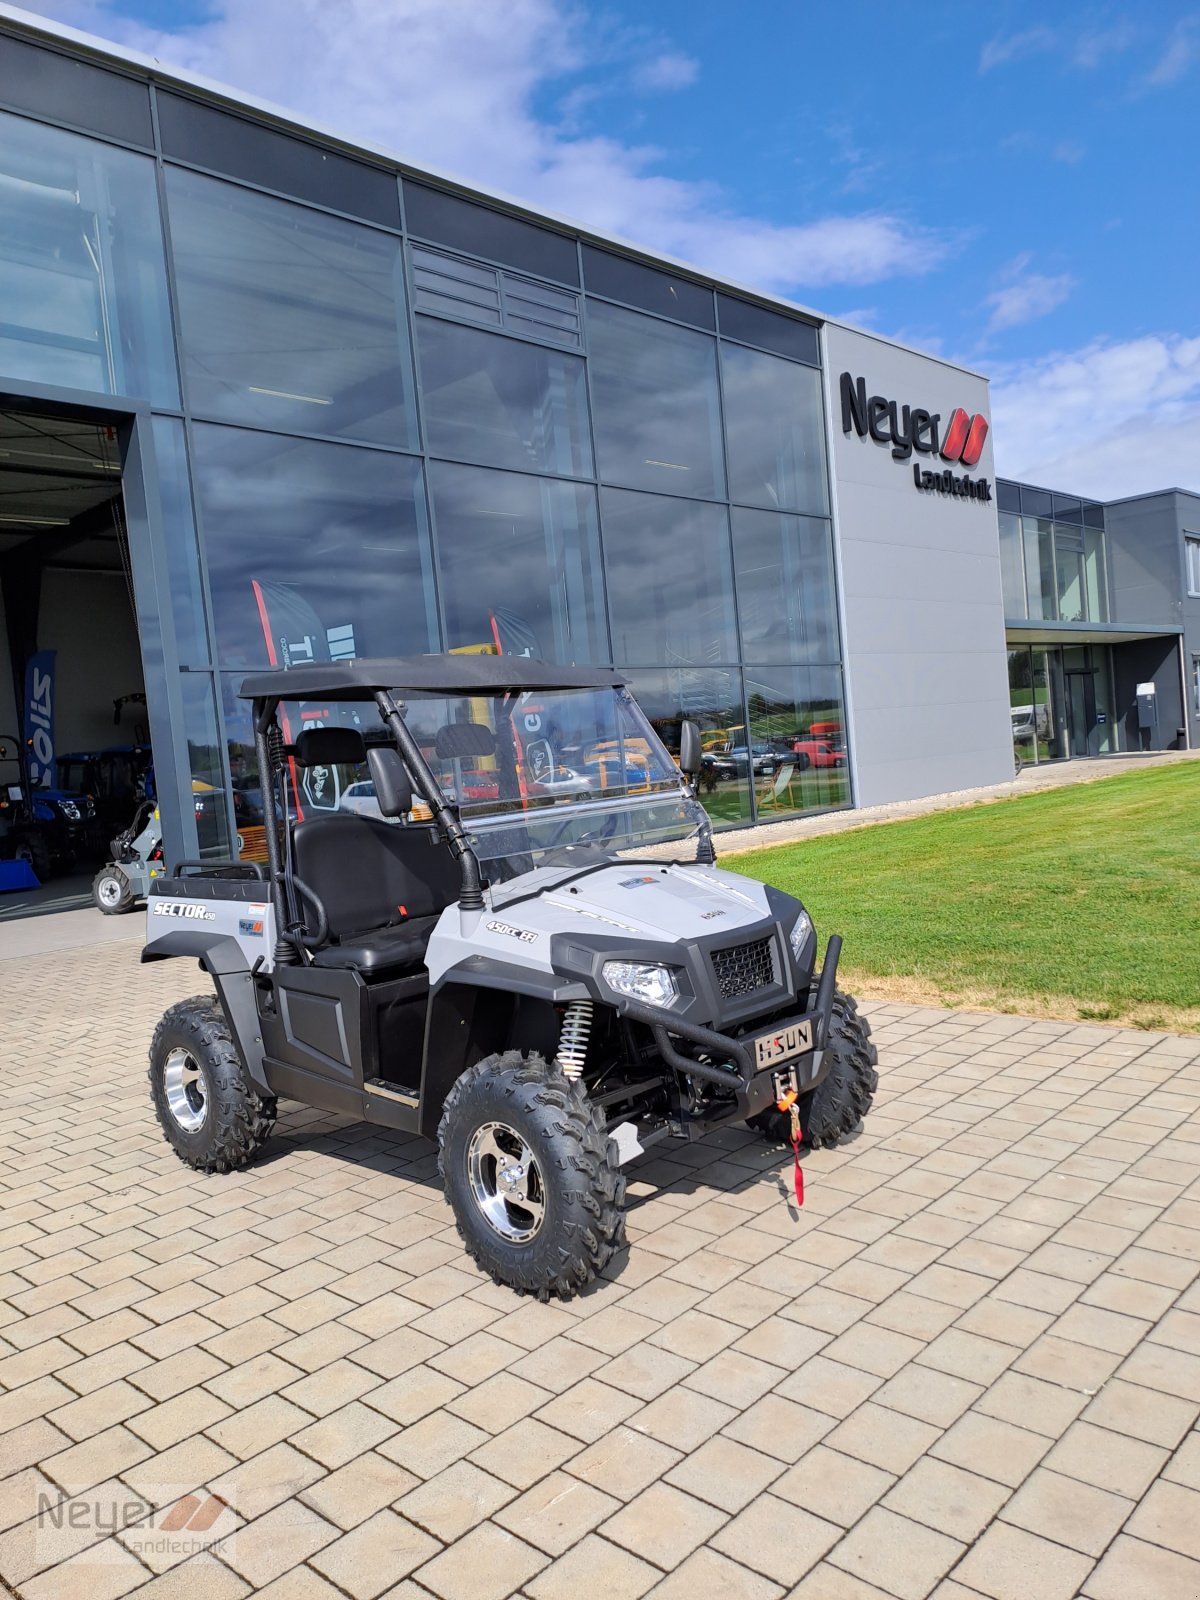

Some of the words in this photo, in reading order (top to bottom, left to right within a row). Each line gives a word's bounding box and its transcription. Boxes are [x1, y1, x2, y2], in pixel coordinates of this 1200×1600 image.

[840, 372, 940, 458] Neyer
[154, 902, 206, 919] SECTOR
[519, 930, 538, 943] EFI
